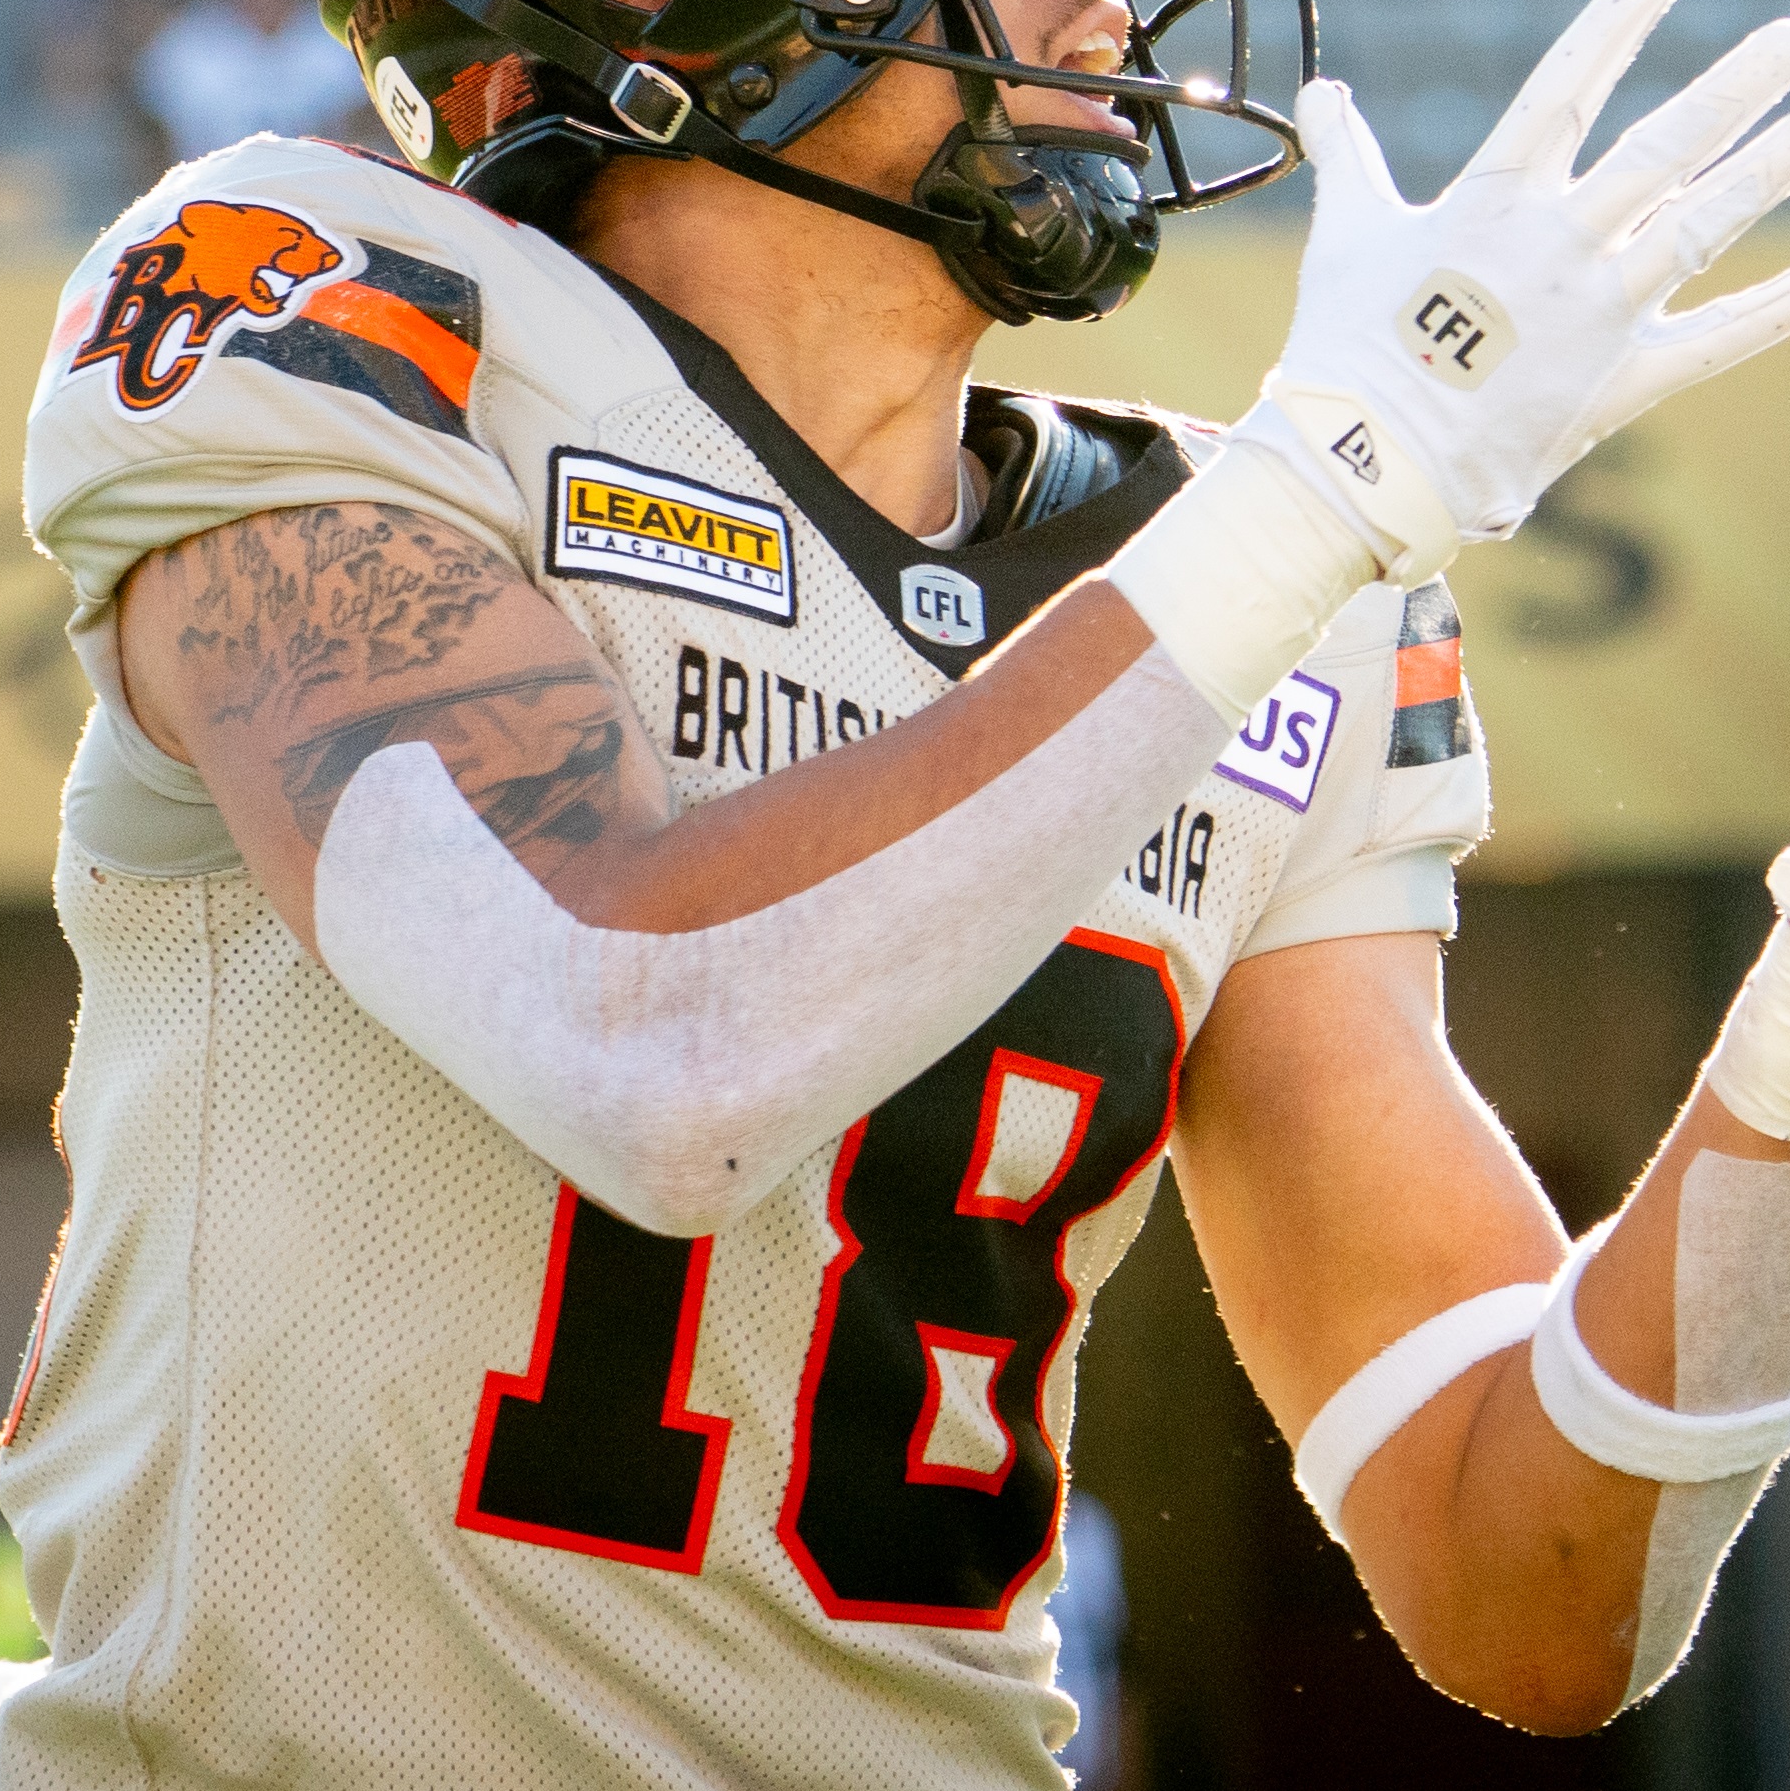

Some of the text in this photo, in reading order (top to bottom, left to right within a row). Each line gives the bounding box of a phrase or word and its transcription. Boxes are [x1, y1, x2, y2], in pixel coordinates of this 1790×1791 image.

[68, 243, 245, 412] BC
[1415, 293, 1485, 371] CFL
[575, 529, 777, 589] MACHINERY
[576, 487, 773, 562] LEAVITT
[915, 585, 972, 628] CFL
[672, 644, 903, 776] BRITI
[455, 925, 1187, 1631] 18
